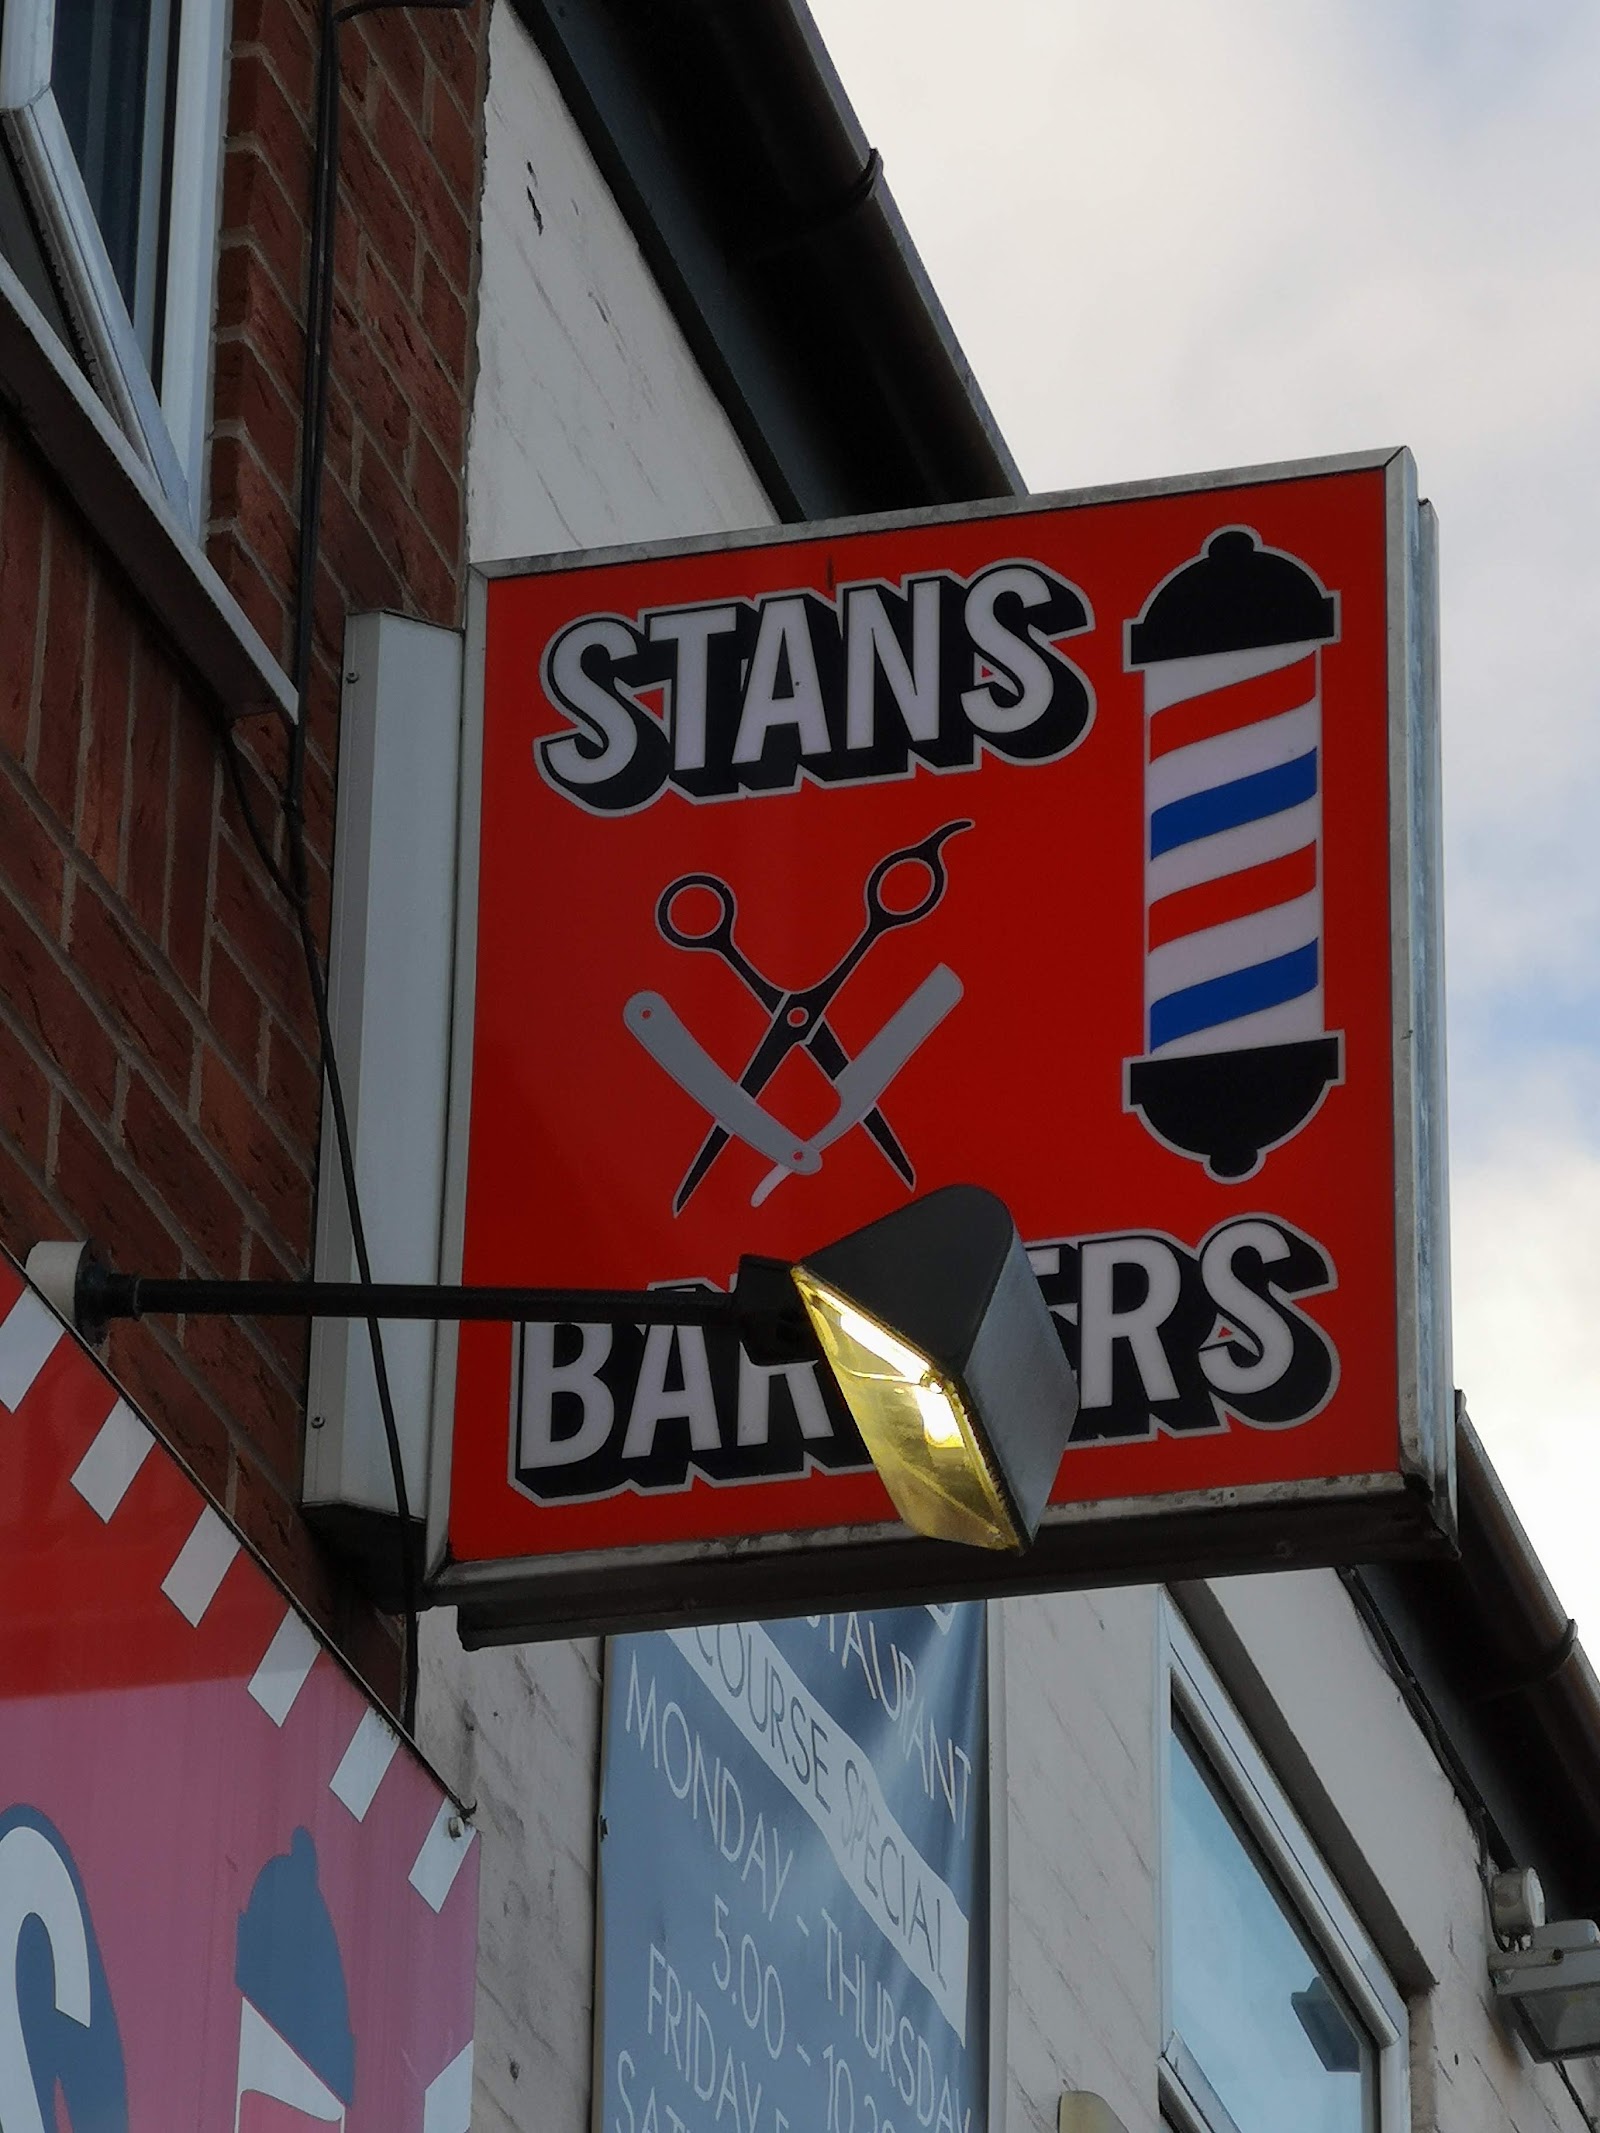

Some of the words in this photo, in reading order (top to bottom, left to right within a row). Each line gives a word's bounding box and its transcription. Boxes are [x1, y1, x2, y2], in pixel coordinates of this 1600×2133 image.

[535, 558, 1096, 815] STANS
[508, 1213, 1340, 1507] BARS
[625, 1649, 793, 1921] MONDAY
[647, 1942, 762, 2133] FRIDAY
[711, 1893, 785, 2060] 5.00
